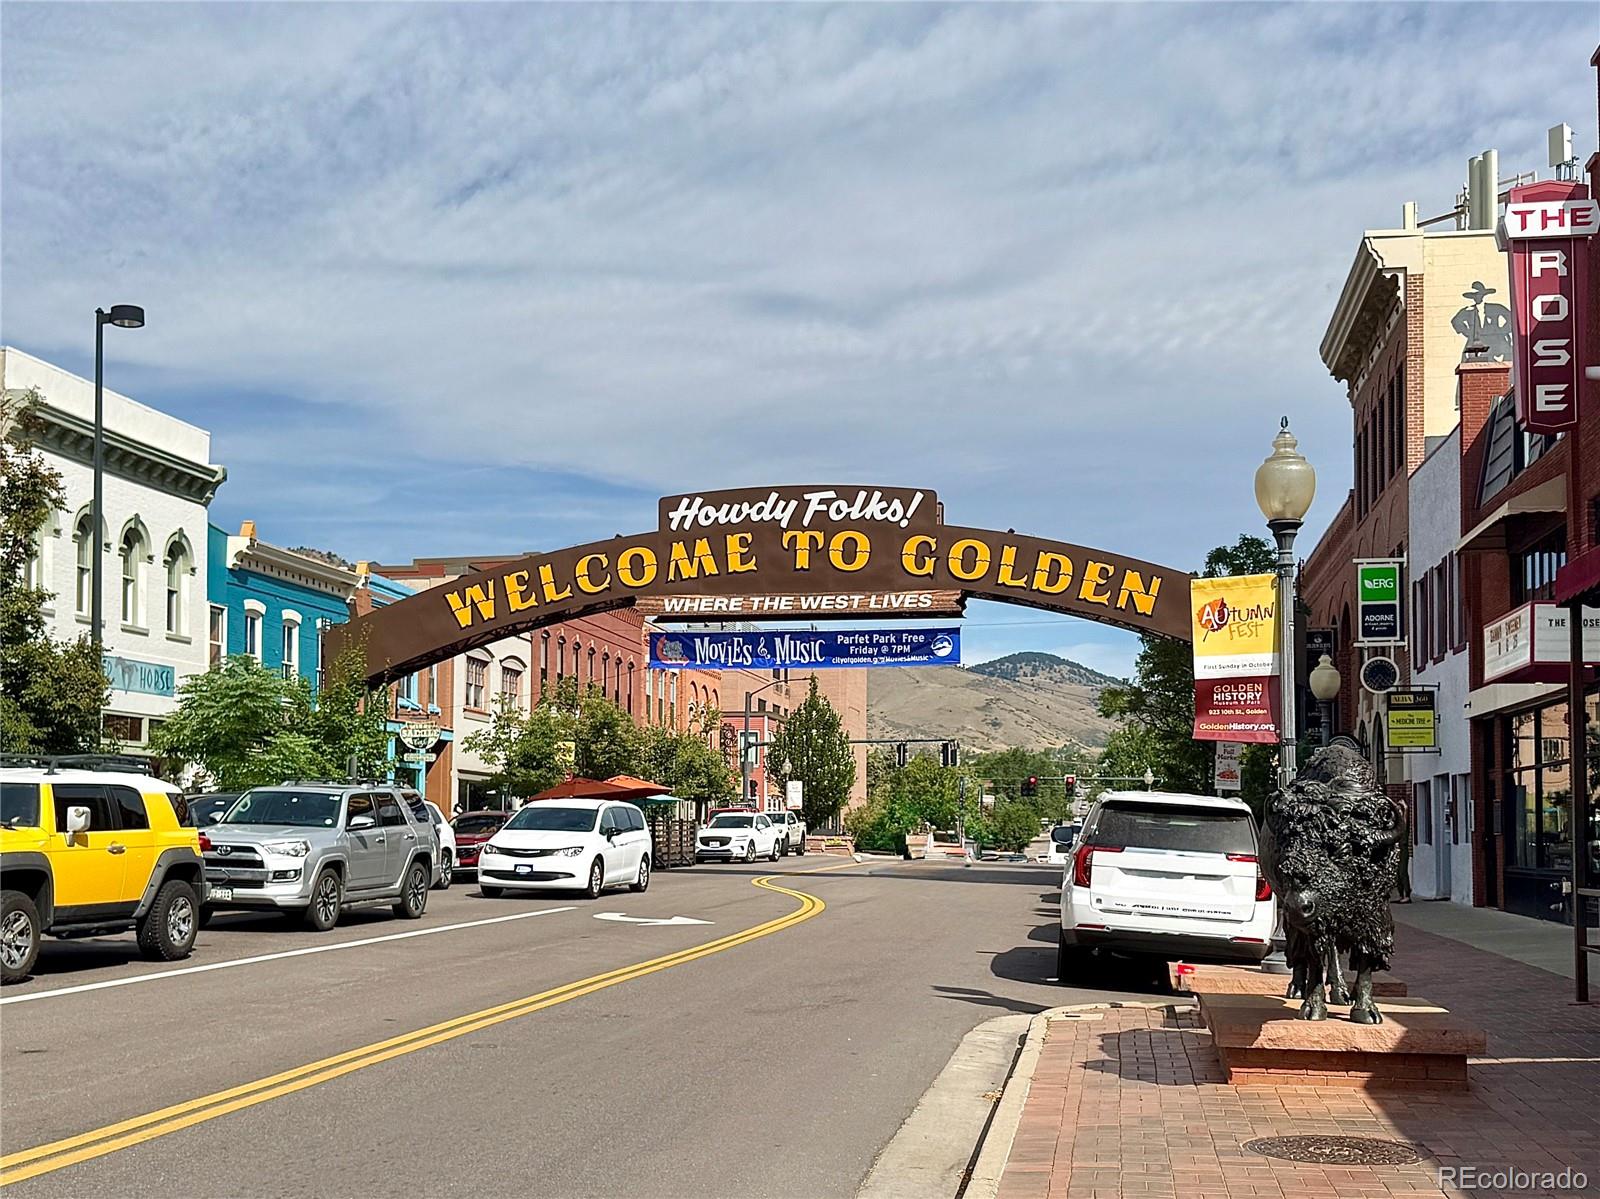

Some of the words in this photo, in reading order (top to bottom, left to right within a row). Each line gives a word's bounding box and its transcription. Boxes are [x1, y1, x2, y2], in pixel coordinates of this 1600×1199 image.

[1511, 206, 1594, 231] THE
[1531, 250, 1571, 412] ROSE
[668, 491, 798, 531] Howdy
[802, 490, 925, 528] Folks!
[445, 532, 758, 628] WELCOME
[782, 530, 871, 572] TO
[901, 535, 1162, 616] GOLDEN
[1373, 578, 1394, 588] ERG
[663, 596, 744, 612] WHERE
[751, 597, 796, 610] THE
[801, 595, 867, 610] WEST
[868, 594, 933, 608] LIVES
[1364, 614, 1395, 622] ADORNE
[1548, 618, 1566, 627] THE
[837, 634, 869, 645] Parfet
[873, 634, 896, 644] Park
[902, 633, 925, 643] Free
[849, 646, 878, 655] Friday
[881, 645, 889, 654] @
[891, 645, 911, 654] 7PM
[1213, 683, 1263, 693] GOLDEN
[1213, 691, 1262, 701] HISTORY
[1199, 722, 1276, 731] GoldenHistory.org
